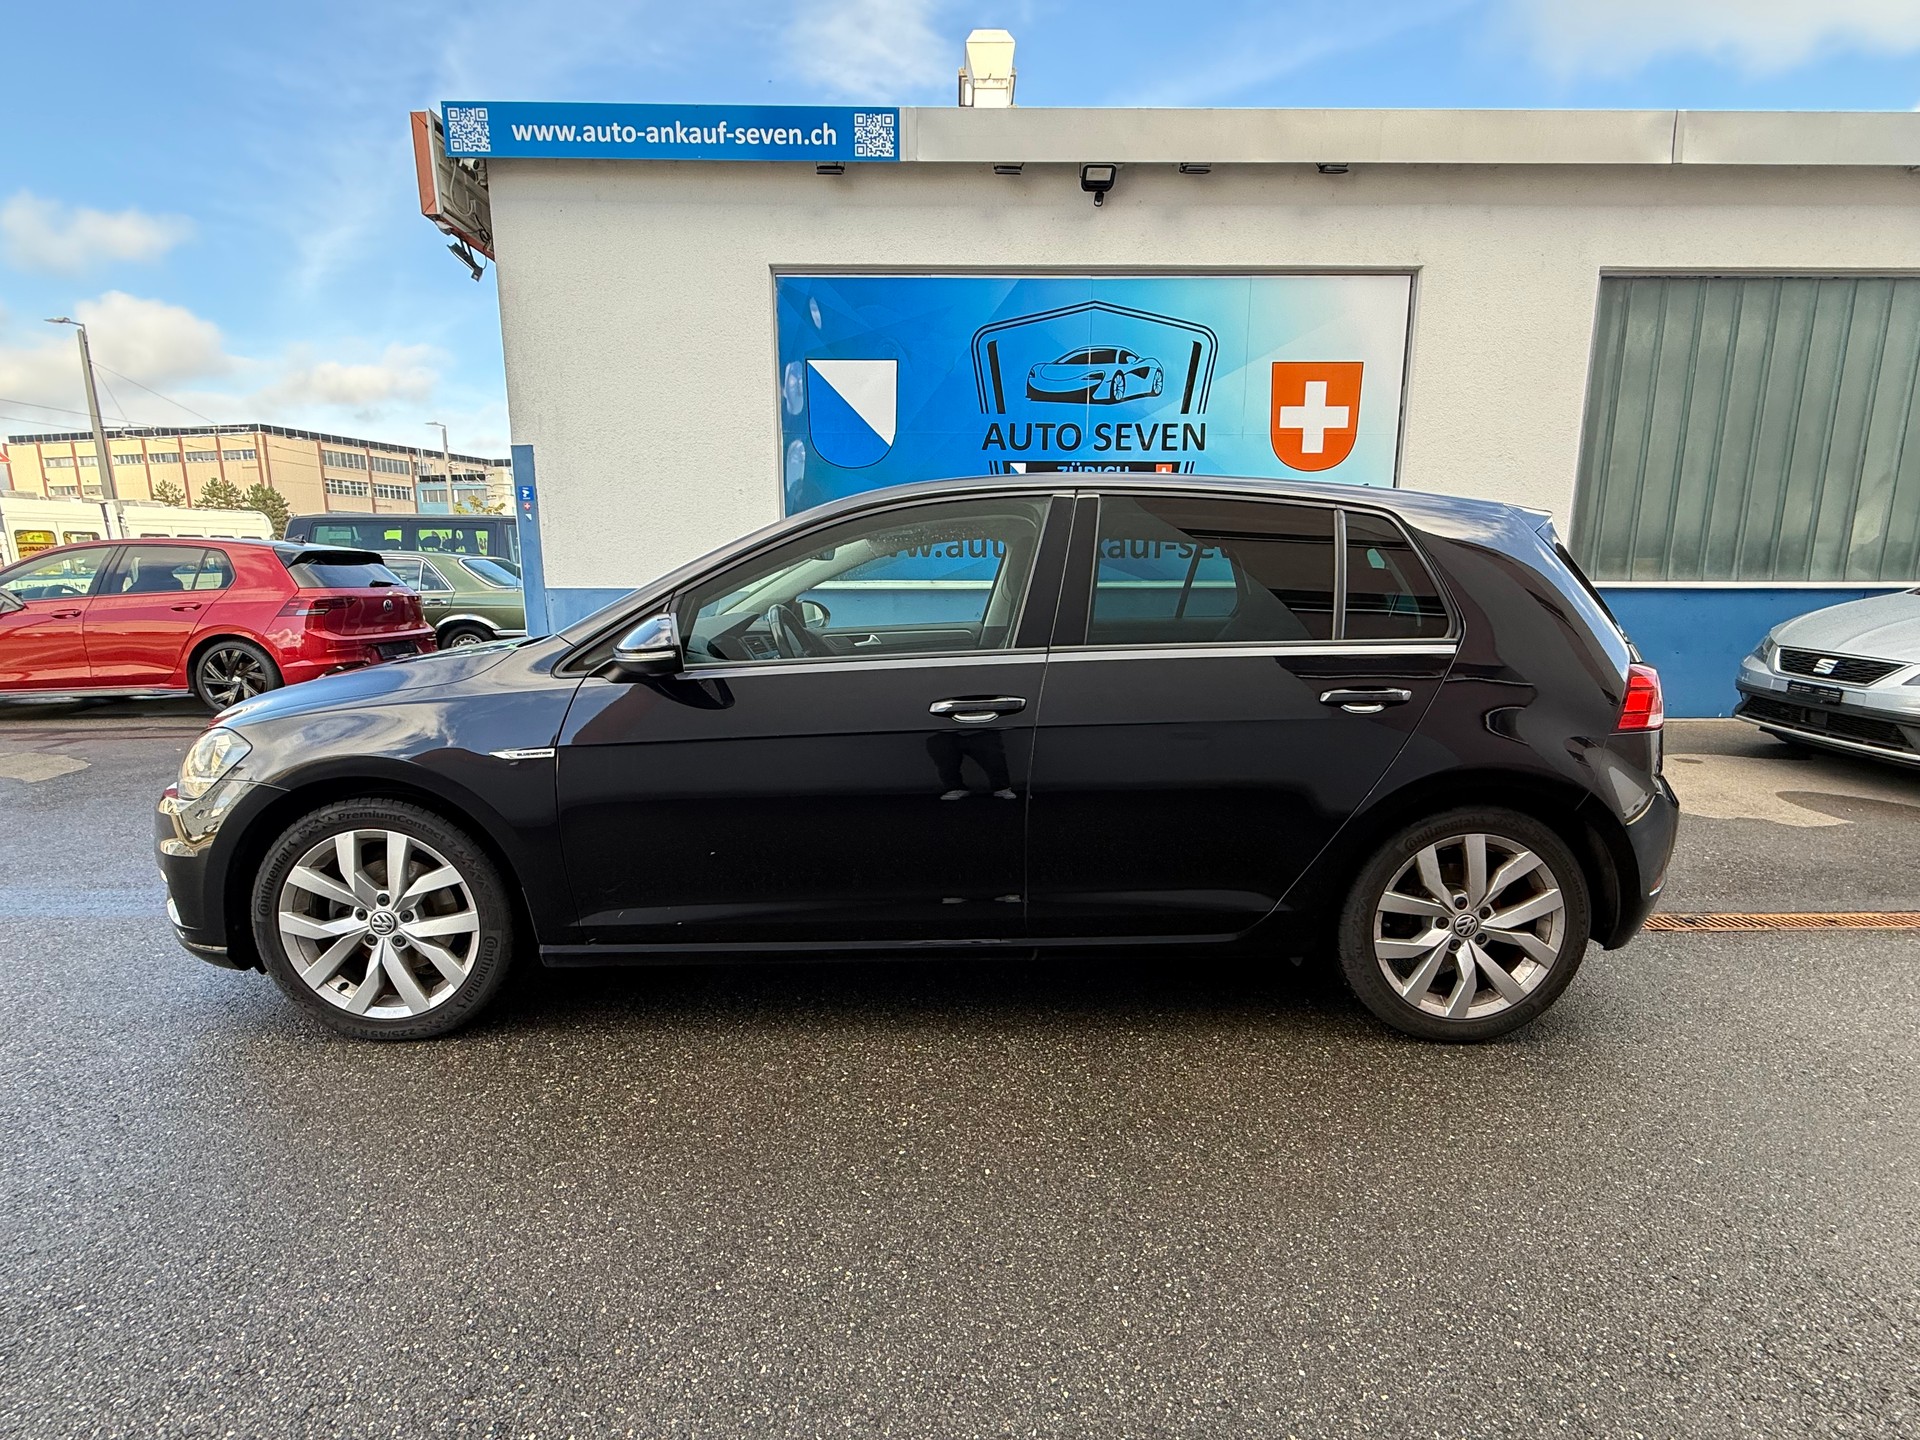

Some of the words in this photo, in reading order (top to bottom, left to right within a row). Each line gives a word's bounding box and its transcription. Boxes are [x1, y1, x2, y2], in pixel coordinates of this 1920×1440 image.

[512, 121, 837, 146] www.auto-ankauf-seven.ch
[981, 422, 1082, 451] AUTO
[1093, 422, 1206, 451] SEVEN
[337, 811, 446, 842] PremiumContact
[257, 847, 291, 916] Continental
[463, 934, 498, 1002] Continental
